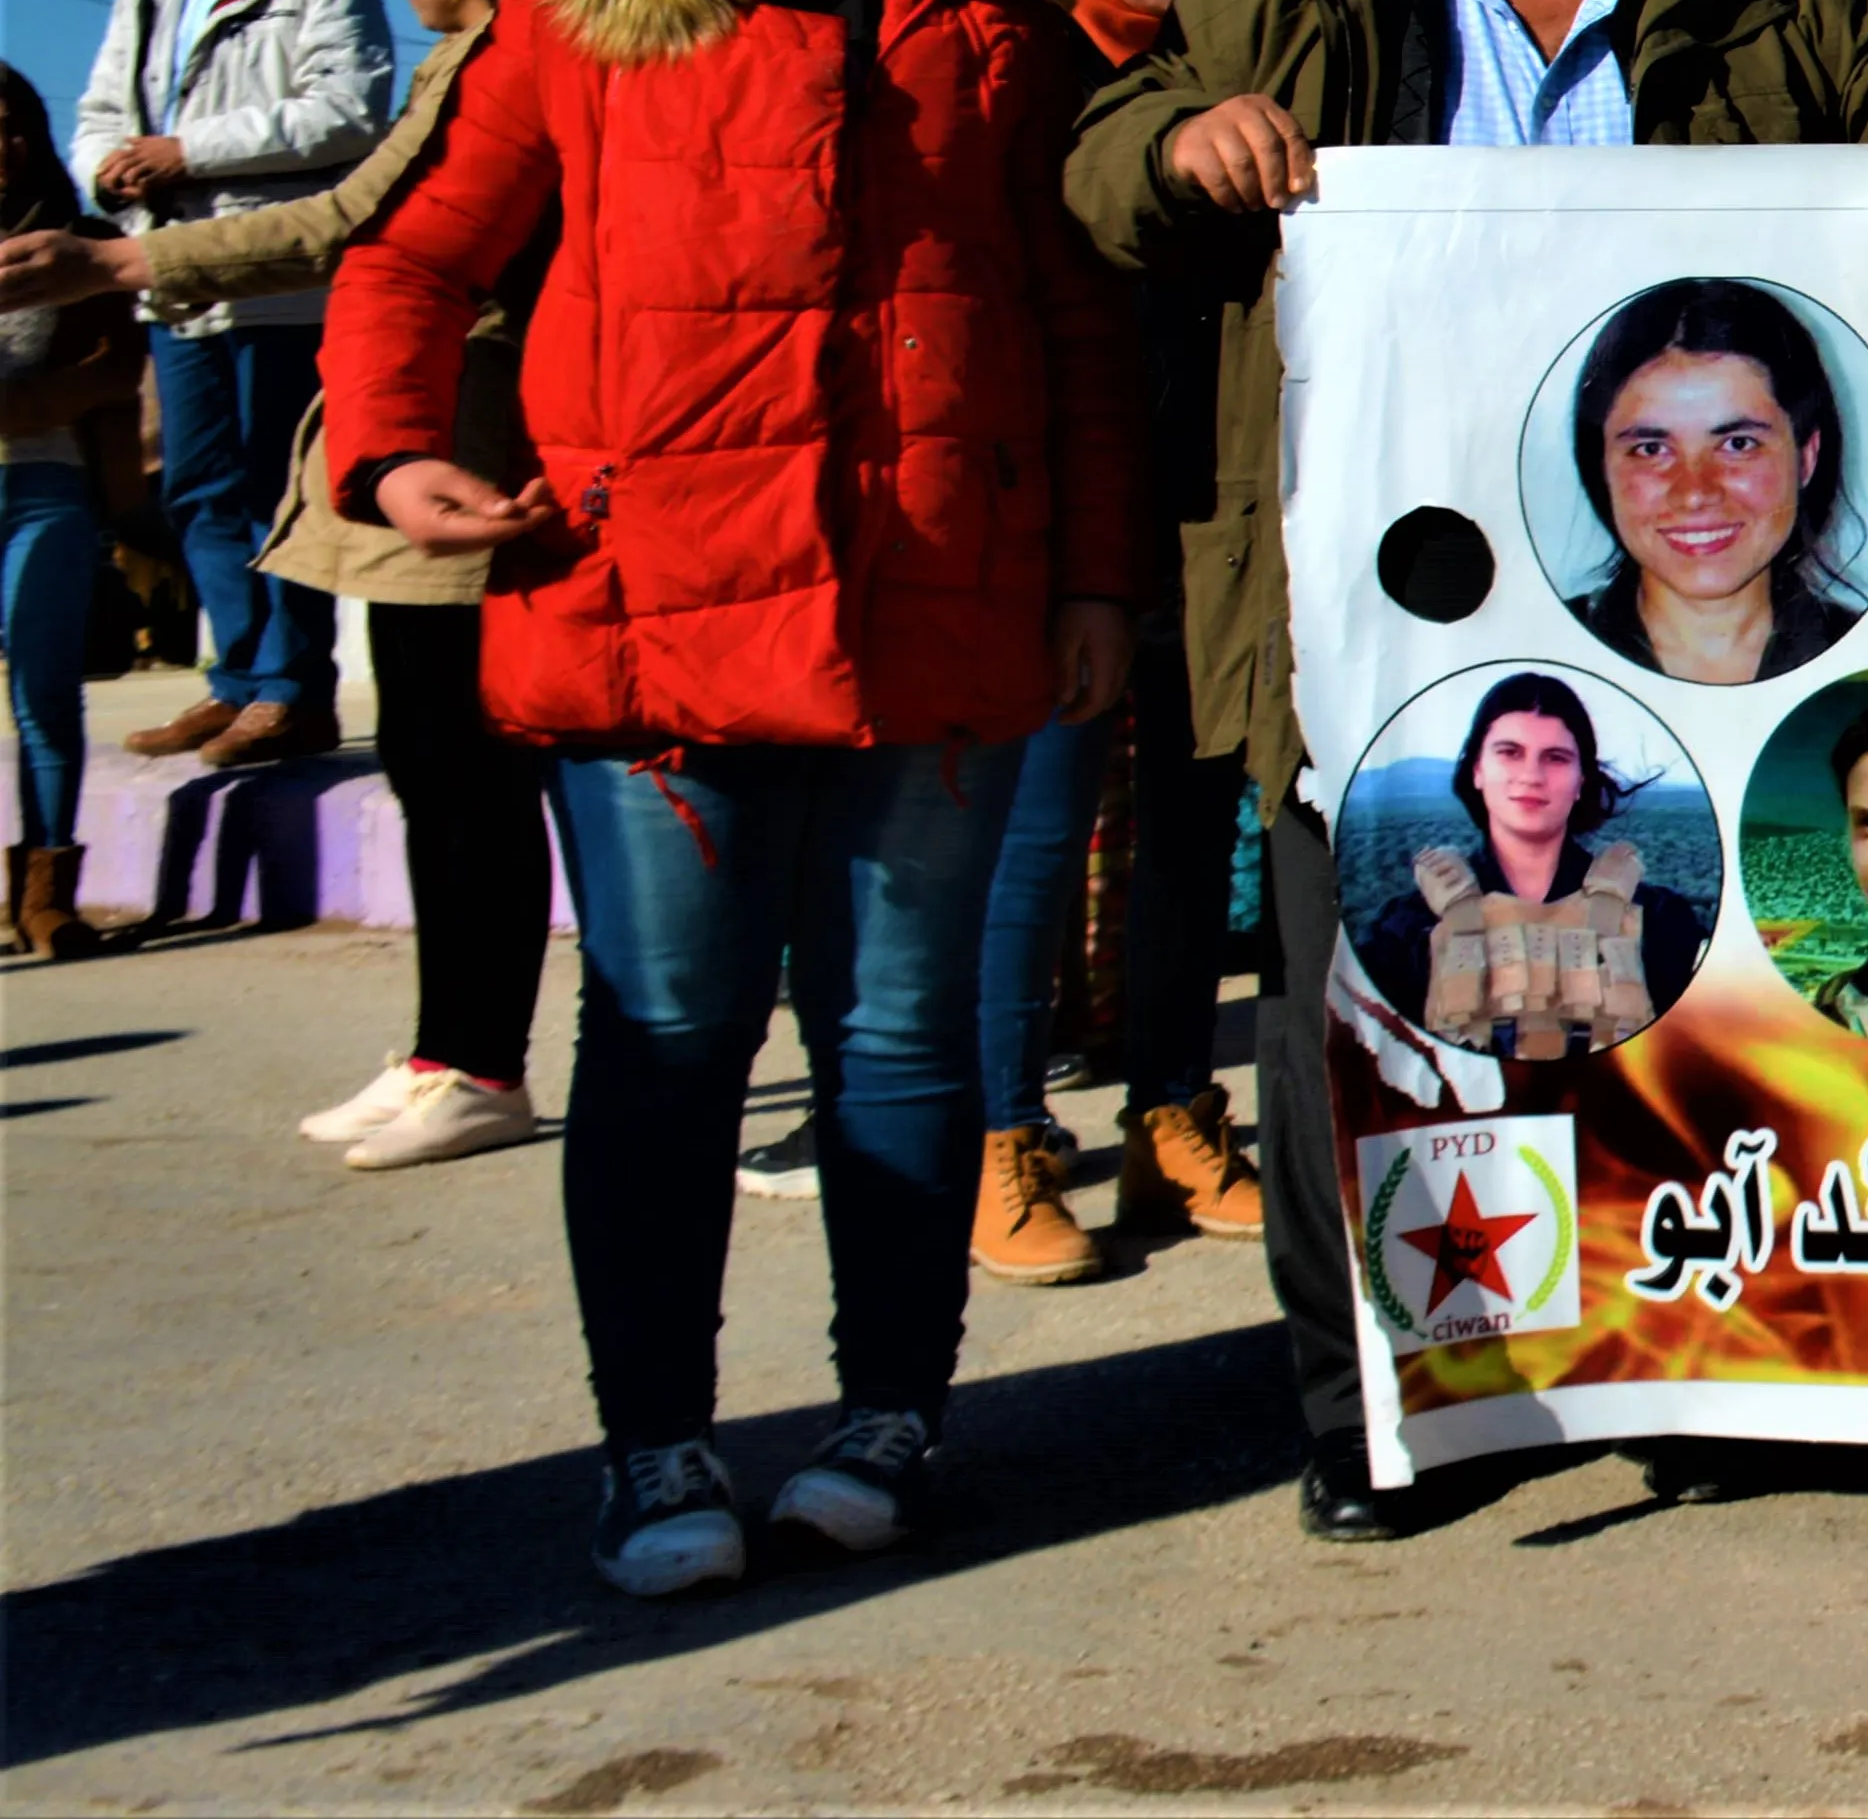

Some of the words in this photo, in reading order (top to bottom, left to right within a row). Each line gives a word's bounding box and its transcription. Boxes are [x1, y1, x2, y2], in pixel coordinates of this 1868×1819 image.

[1430, 1130, 1497, 1161] PYD
[1632, 1141, 1771, 1302] آبو
[1432, 1312, 1512, 1342] ciwan
